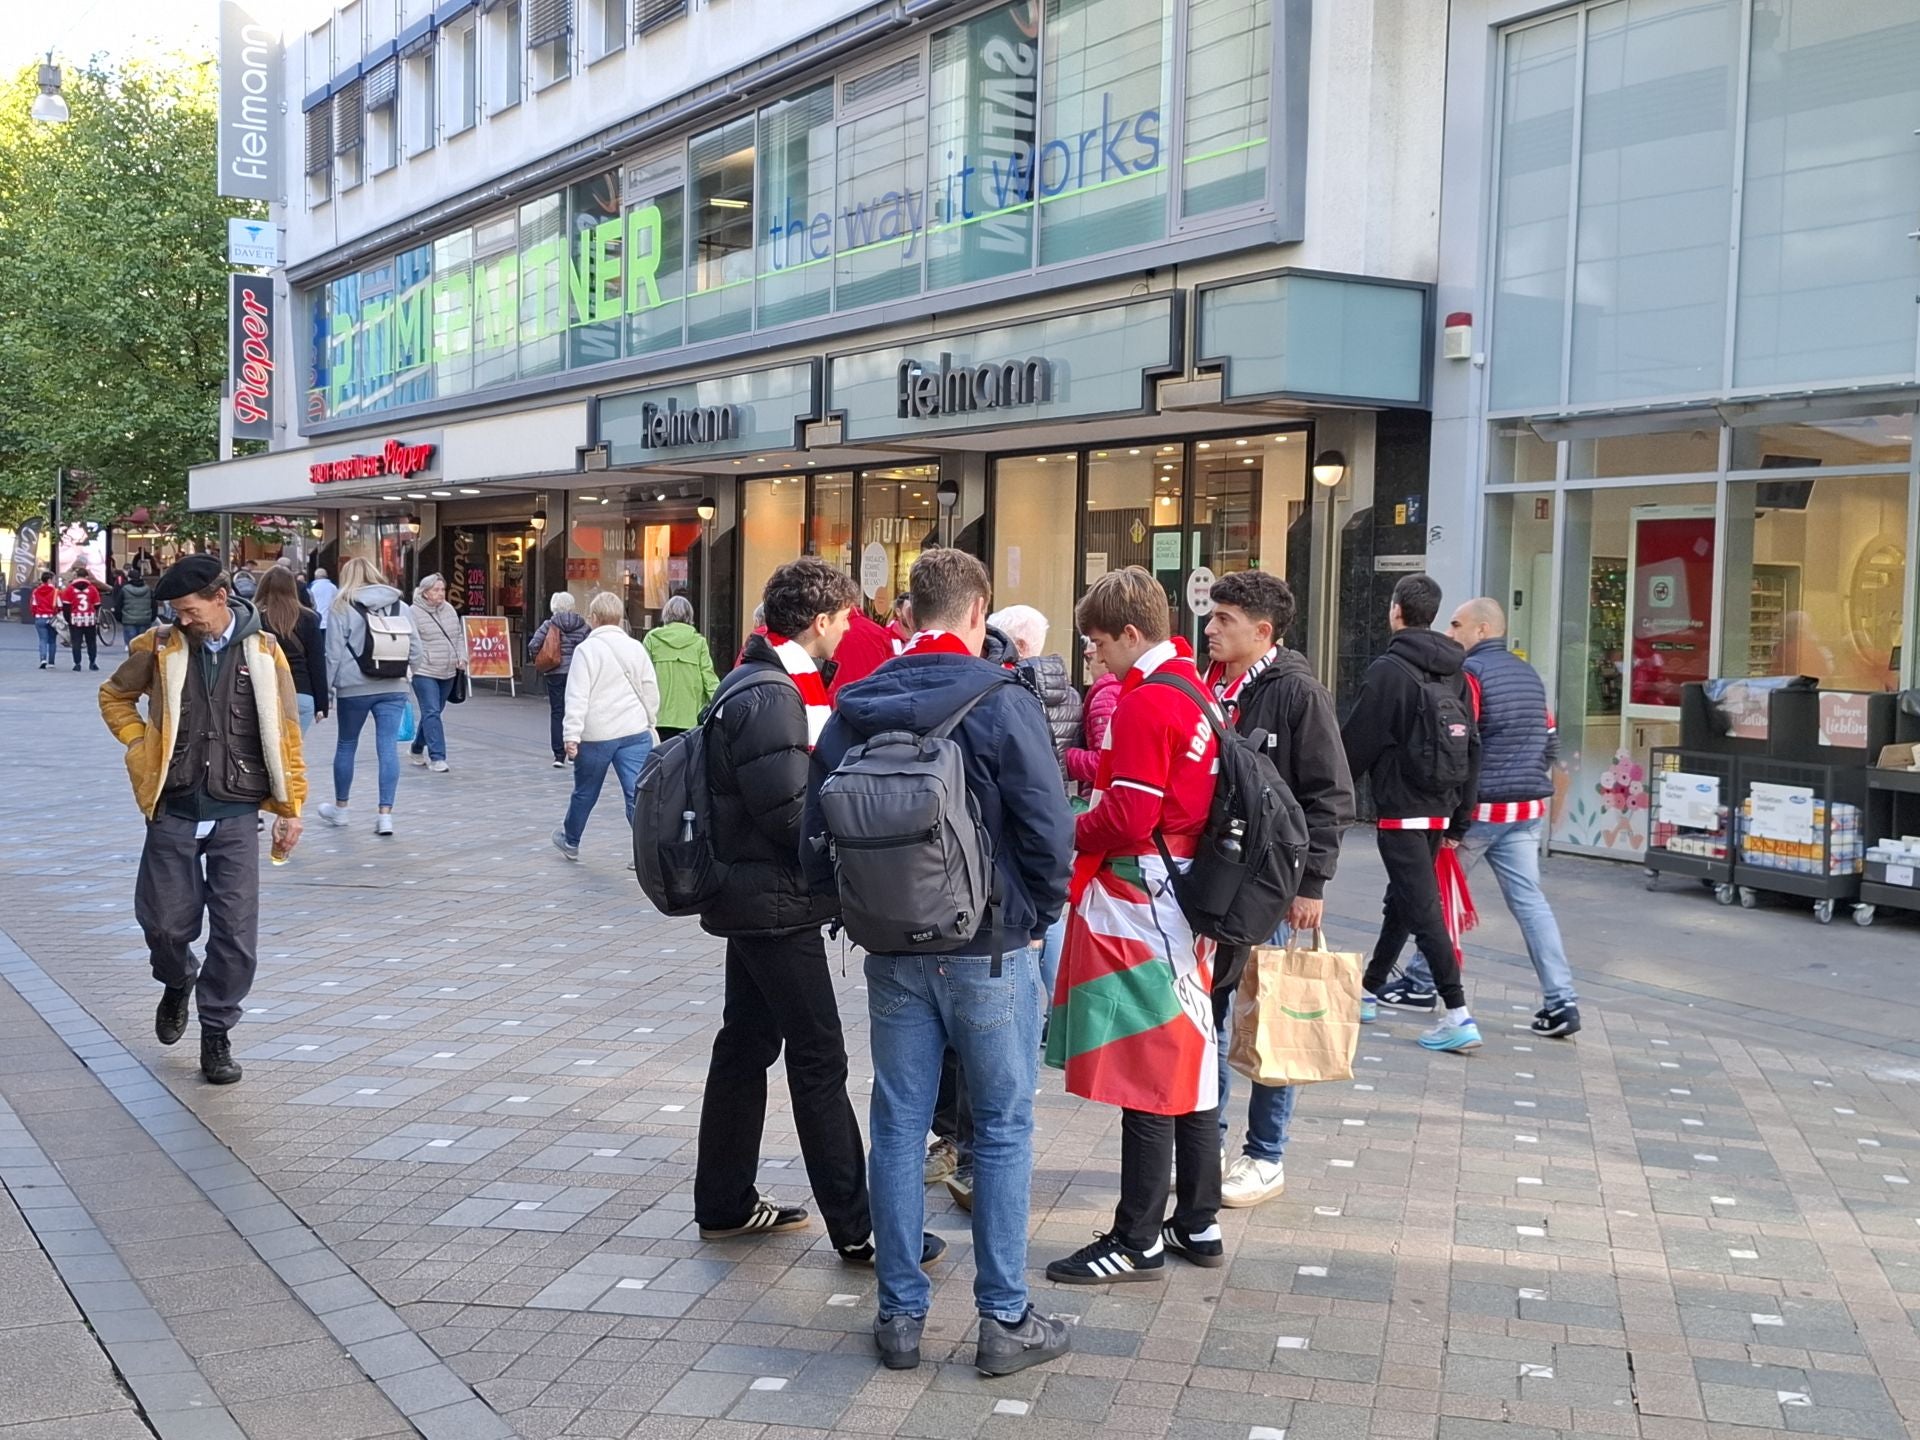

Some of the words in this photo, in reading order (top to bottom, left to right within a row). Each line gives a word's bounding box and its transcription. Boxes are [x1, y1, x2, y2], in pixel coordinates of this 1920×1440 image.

[232, 23, 267, 179] fielmann
[769, 196, 832, 270] the
[843, 187, 924, 259] way
[947, 150, 975, 222] it
[992, 92, 1160, 208] works
[233, 288, 275, 424] Pieper
[14, 526, 37, 583] Coffee
[76, 594, 88, 611] 3
[472, 637, 505, 651] 20%
